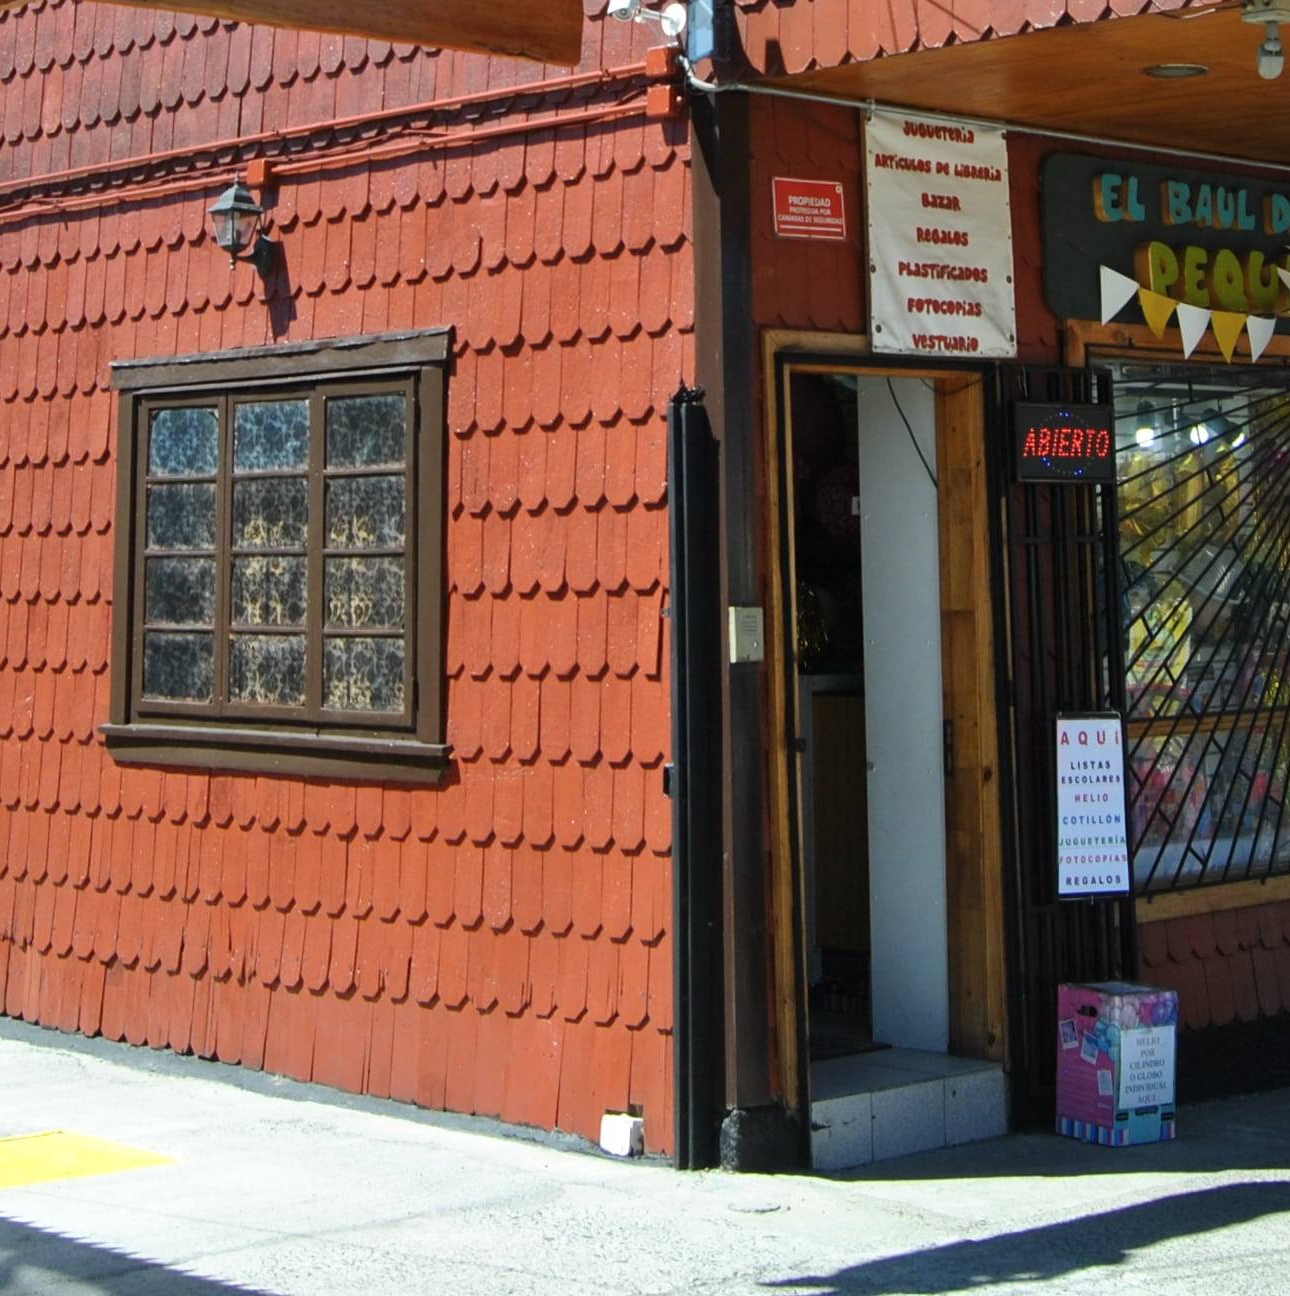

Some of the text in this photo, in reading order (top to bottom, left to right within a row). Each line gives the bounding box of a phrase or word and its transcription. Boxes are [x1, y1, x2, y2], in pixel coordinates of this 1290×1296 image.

[936, 161, 950, 176] DE
[1094, 173, 1145, 222] EL
[1162, 181, 1256, 231] BAUL
[1022, 427, 1109, 458] ABIERTO
[1070, 760, 1111, 770] LISTAS
[1061, 775, 1121, 784] ESCOLARES
[1075, 793, 1109, 803] HELIO
[1062, 814, 1121, 825] COTILLÓN
[1059, 854, 1127, 864] FOTOCOPIAS
[1065, 875, 1121, 886] REGALOS
